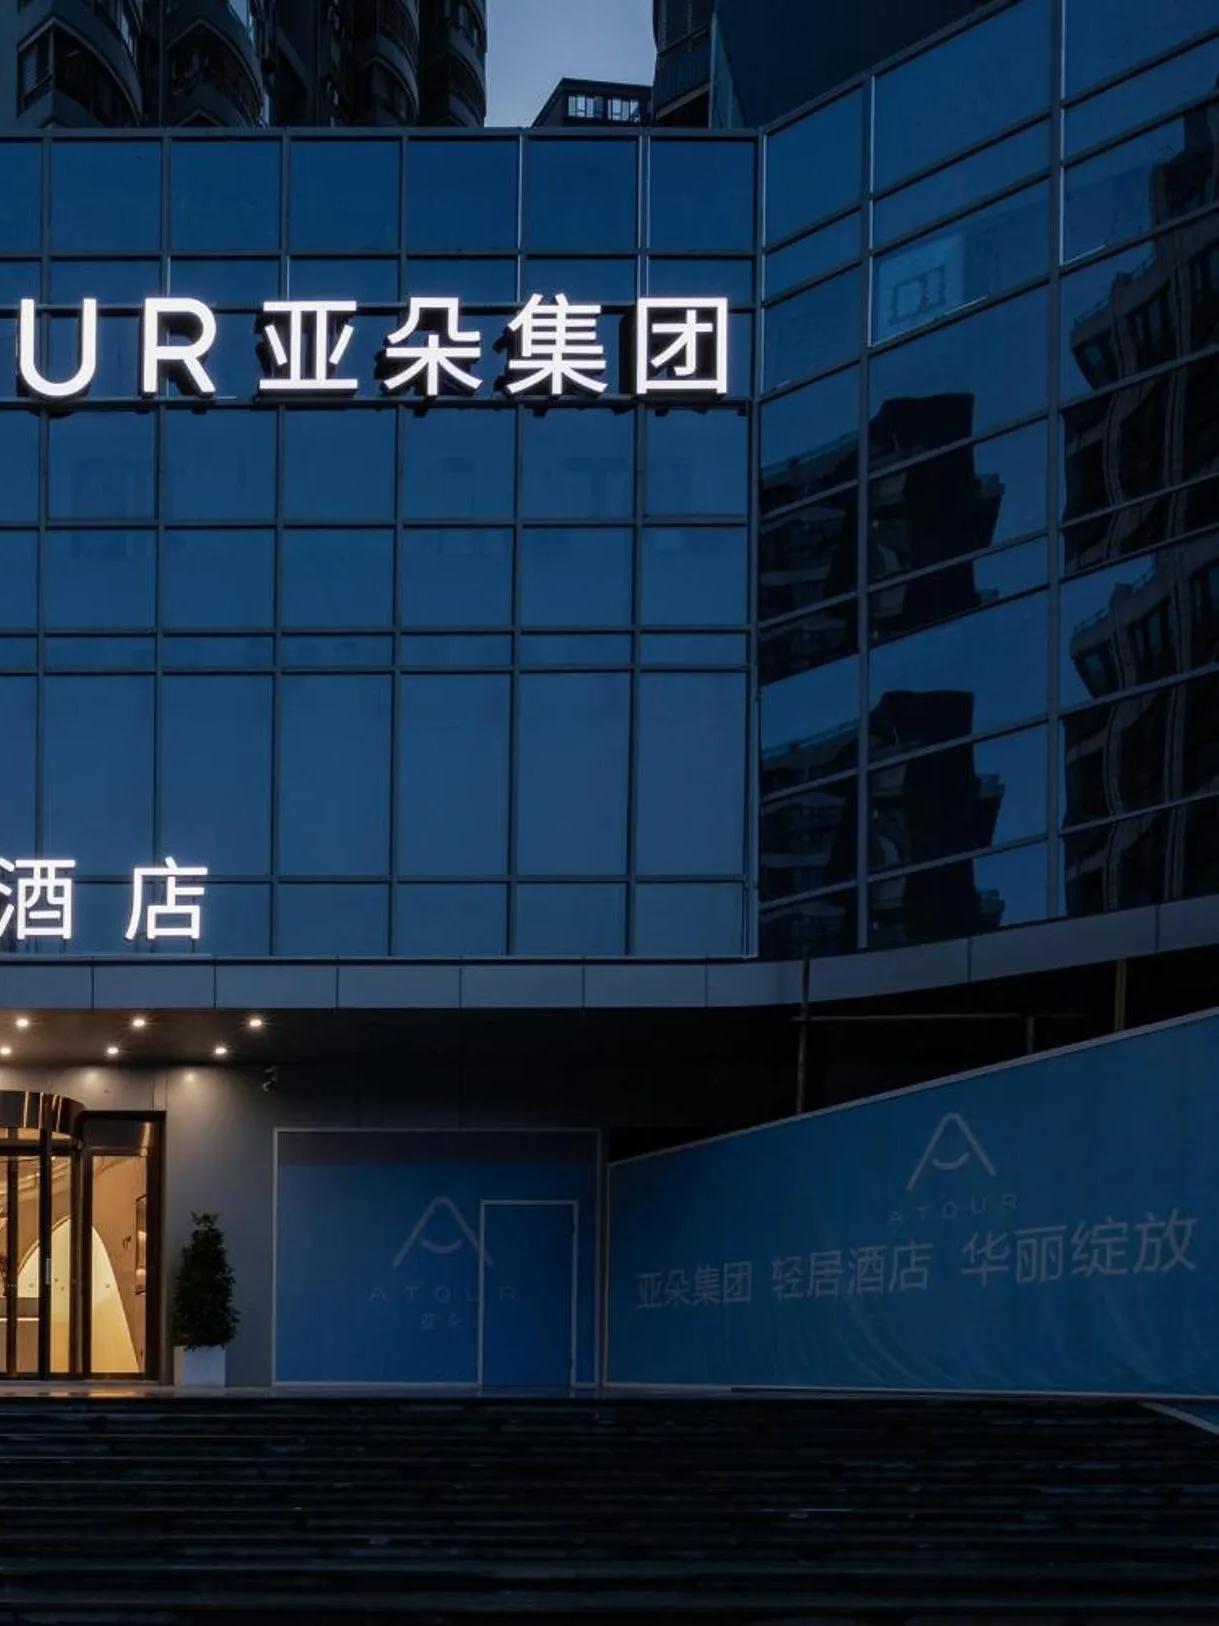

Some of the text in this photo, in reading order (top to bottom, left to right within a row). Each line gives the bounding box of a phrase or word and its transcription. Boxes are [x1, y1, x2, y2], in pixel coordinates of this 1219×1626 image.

[259, 294, 731, 396] 亚朵集团
[635, 1207, 1199, 1310] 亚朵集团 轻居酒店 华丽绽放
[886, 1192, 1019, 1227] ATOUR
